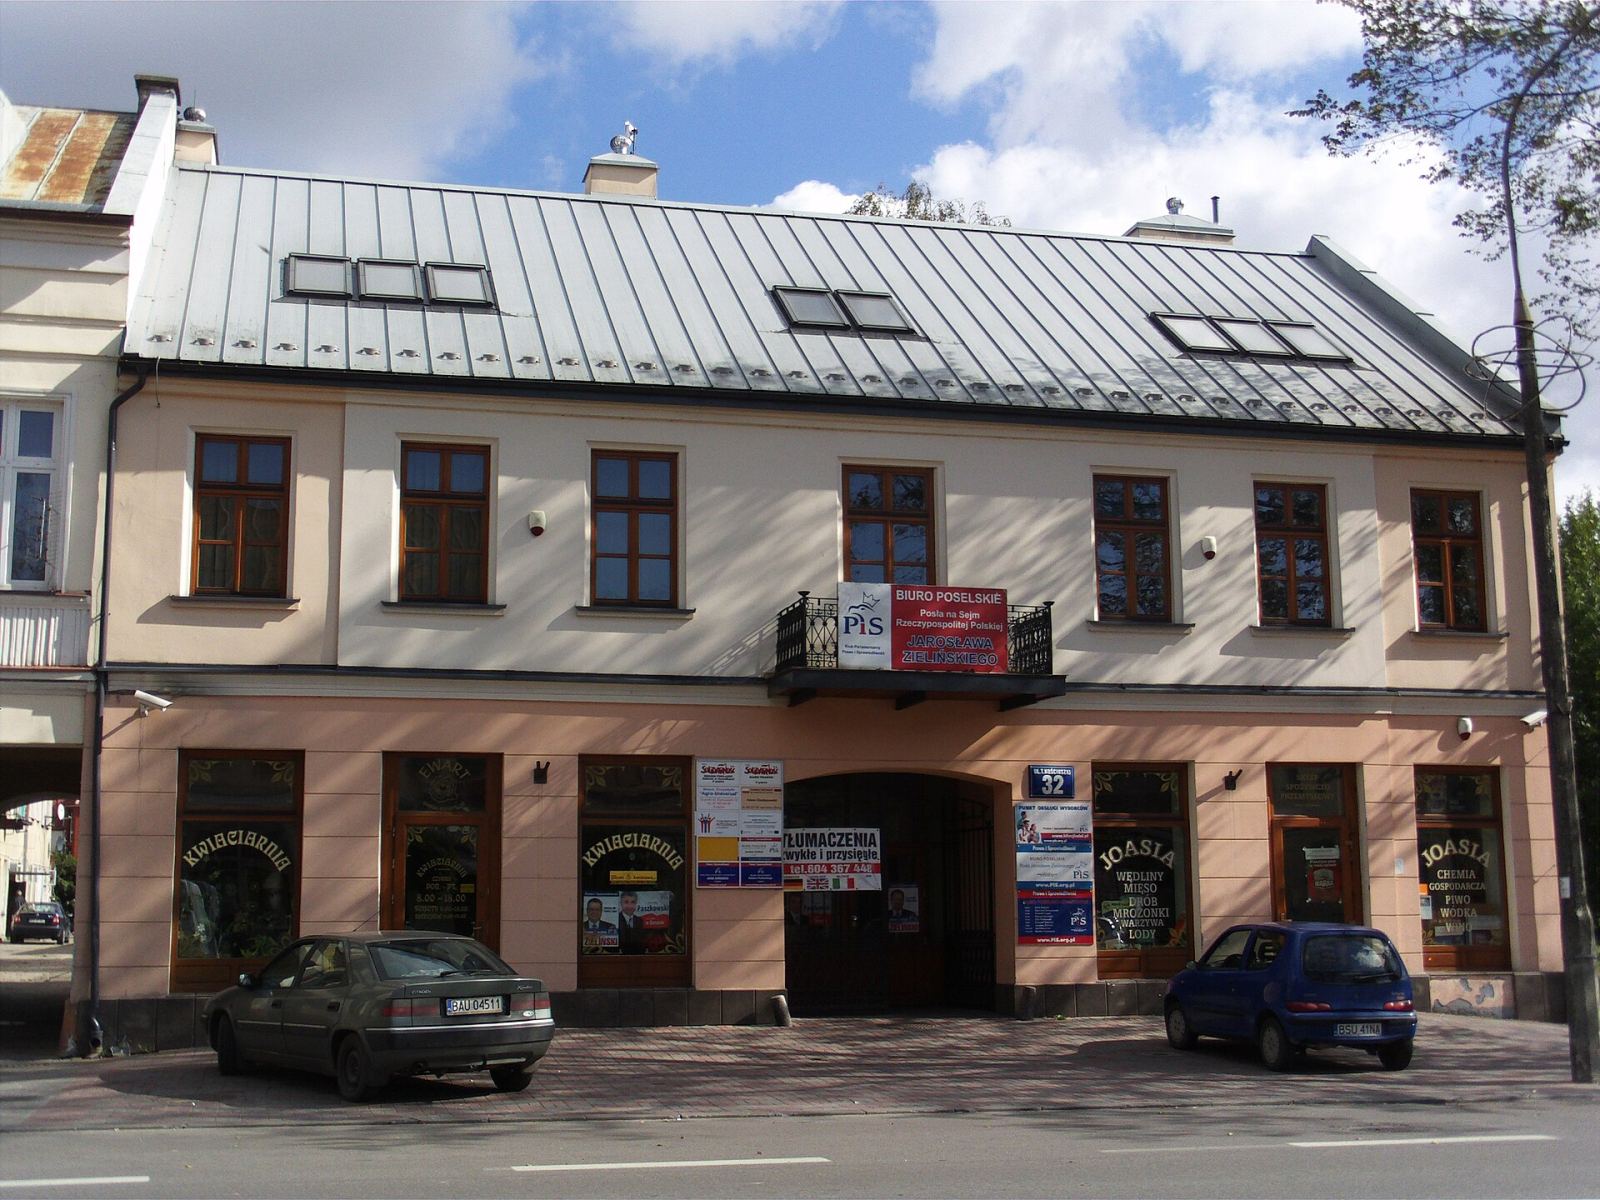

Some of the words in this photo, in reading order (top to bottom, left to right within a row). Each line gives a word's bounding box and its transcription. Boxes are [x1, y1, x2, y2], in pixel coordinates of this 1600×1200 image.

[896, 589, 933, 602] BIURO
[936, 590, 1002, 605] POSELSKIE
[920, 609, 945, 618] Posła
[946, 611, 957, 619] na
[958, 610, 980, 620] Sejm
[843, 614, 884, 636] PiS
[896, 619, 969, 630] Rzeczypospolitej
[970, 620, 1004, 633] Polskiej
[907, 634, 994, 650] JAROSŁAWA
[902, 648, 999, 666] ZIELIŃSKIEGO
[418, 758, 472, 780] EWART
[1041, 774, 1065, 795] 32
[783, 832, 877, 848] TŁUMACZENIA
[182, 829, 293, 873] KWIACIARNIA
[582, 832, 685, 871] KWIACIARNIA
[819, 849, 823, 860] i
[826, 849, 878, 862] przysięgłe
[1099, 839, 1175, 871] JOASIA
[1421, 838, 1490, 868] JOASIA
[830, 864, 851, 873] 367
[1073, 870, 1089, 879] PiS
[1436, 869, 1477, 880] CHEMIA
[1116, 871, 1164, 883] WĘDLINY
[1124, 883, 1158, 895] MIĘSO
[1429, 882, 1485, 891] GOSPODARCZA
[1128, 894, 1158, 906] DRÓB
[1445, 895, 1471, 905] PIWO
[1440, 904, 1478, 918] WÓDKA
[1120, 918, 1164, 928] WARZYWA
[1128, 929, 1157, 940] LODY
[452, 1000, 471, 1012] BAU
[473, 998, 501, 1010] 04511
[1339, 1024, 1358, 1035] BSU
